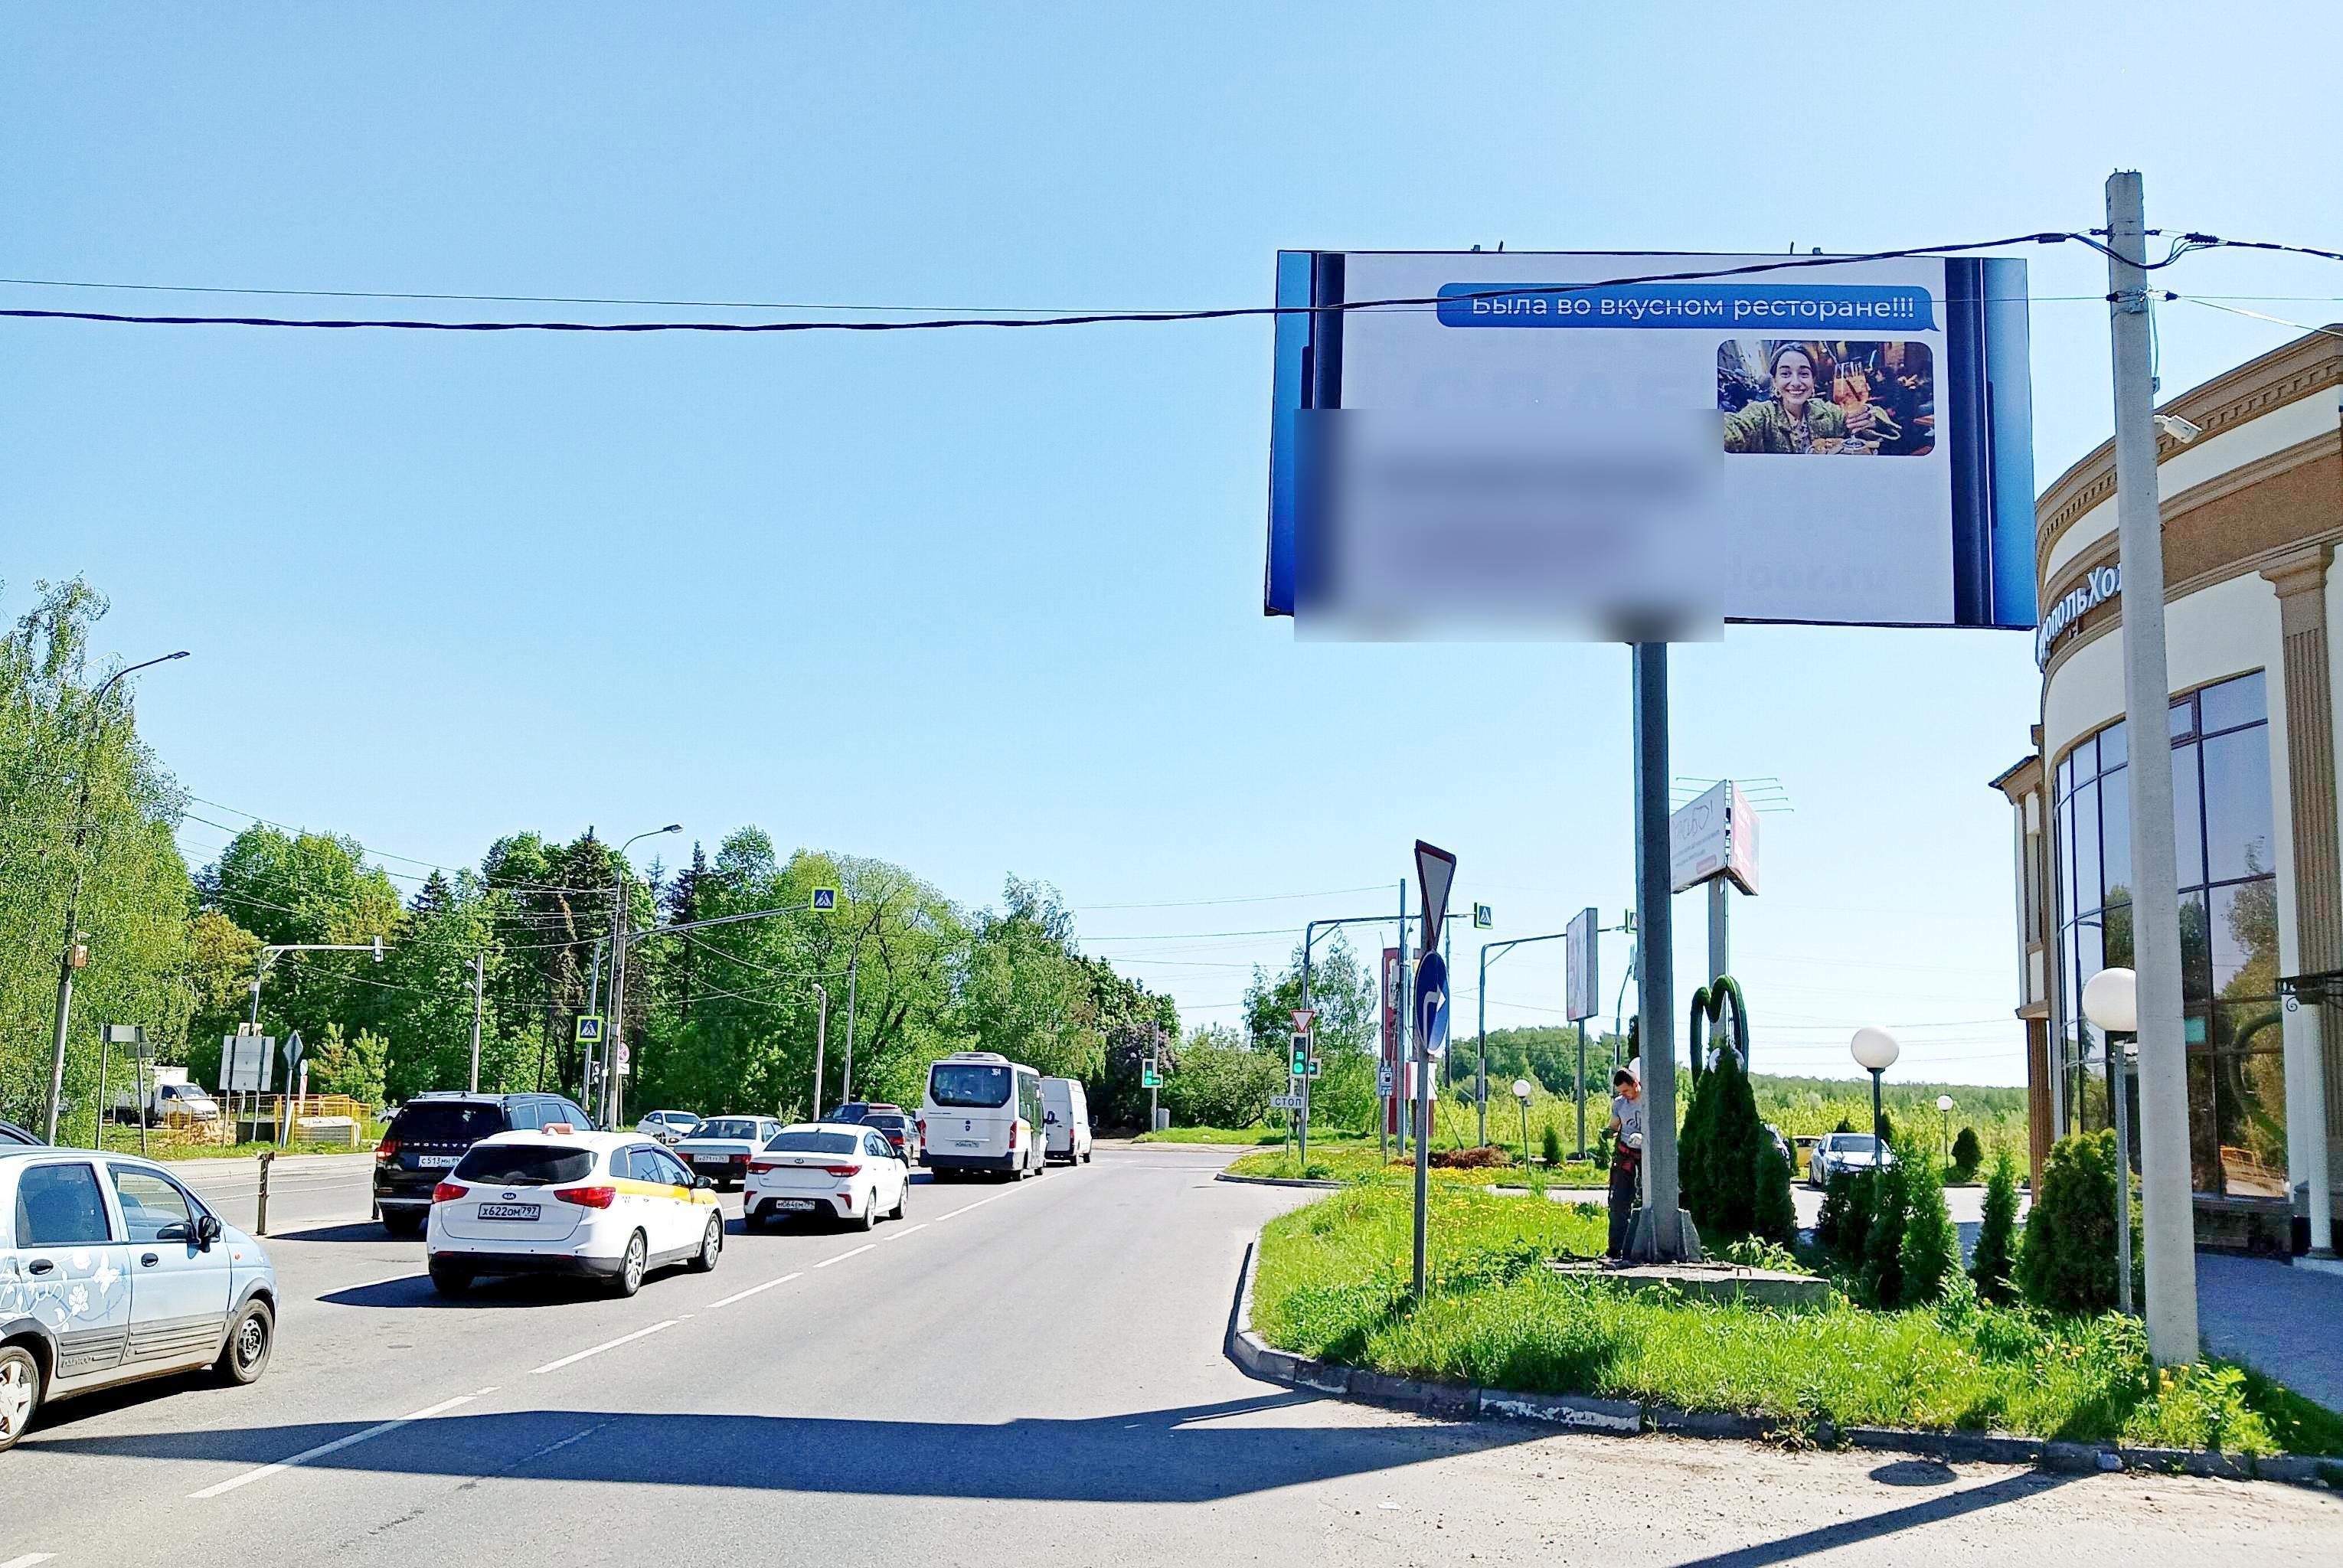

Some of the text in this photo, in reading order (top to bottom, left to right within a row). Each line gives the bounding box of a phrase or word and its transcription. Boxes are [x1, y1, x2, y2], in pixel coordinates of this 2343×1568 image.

[1472, 296, 1914, 322] Была во вкусном ресторане!!!
[1275, 1097, 1302, 1106] СТОП
